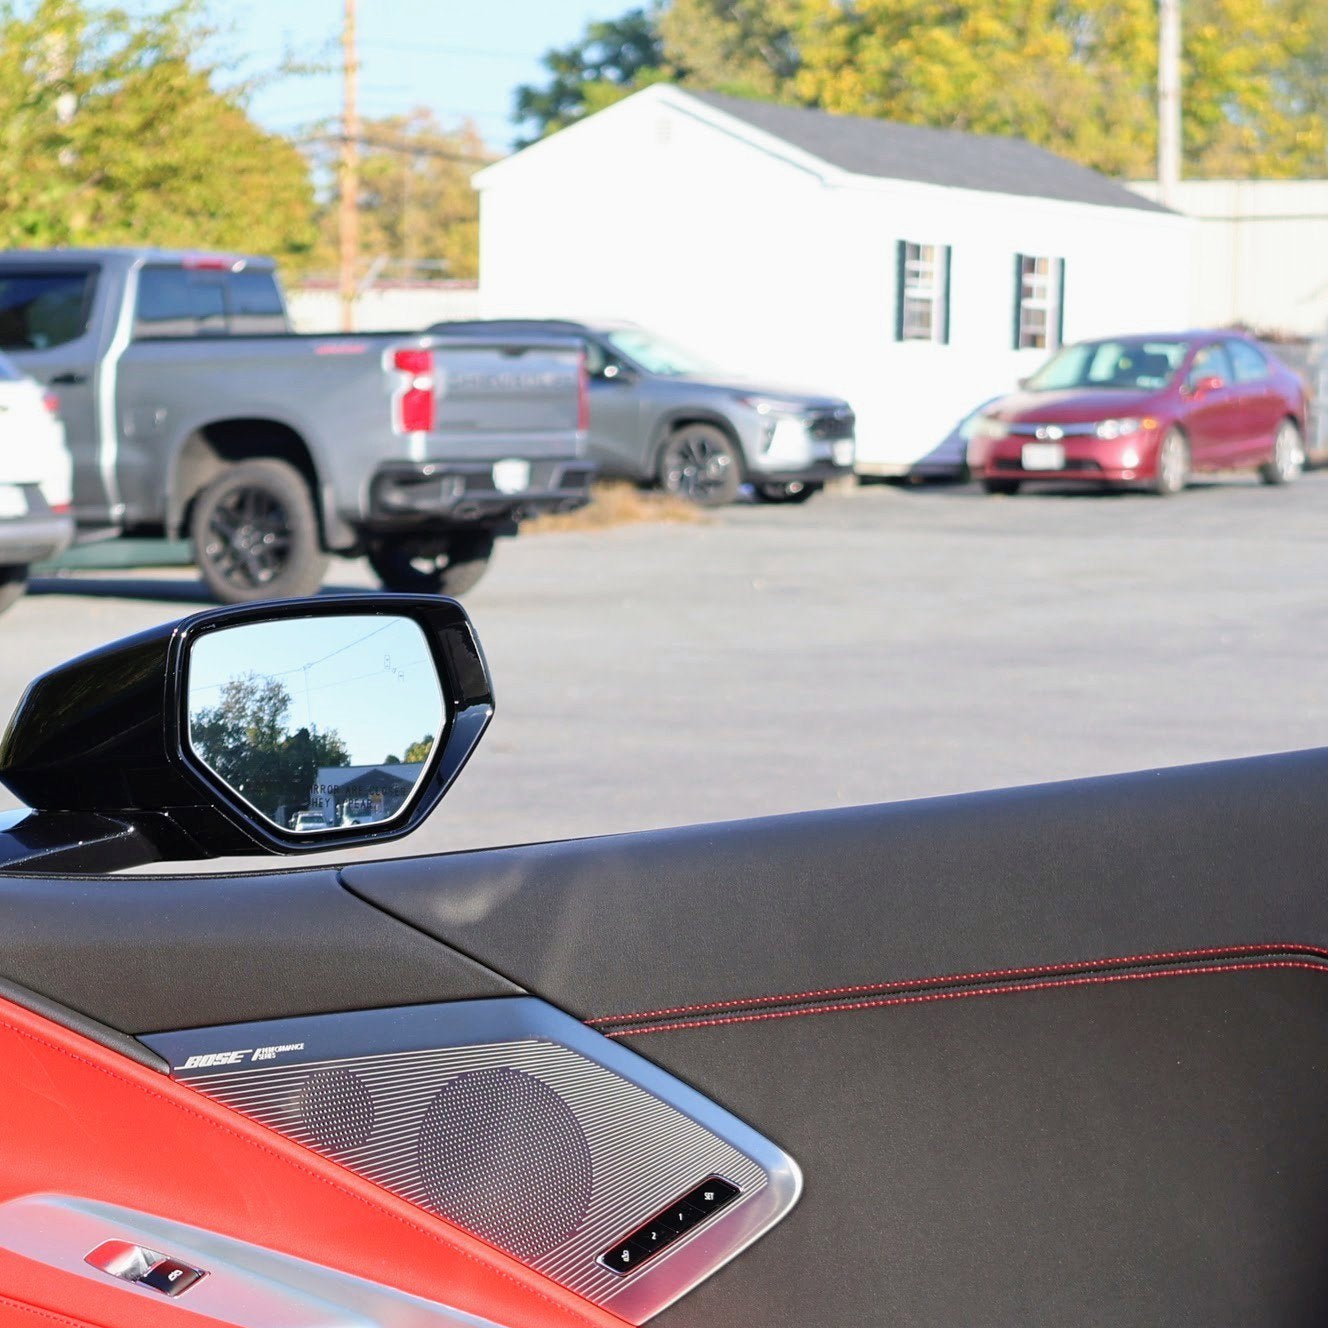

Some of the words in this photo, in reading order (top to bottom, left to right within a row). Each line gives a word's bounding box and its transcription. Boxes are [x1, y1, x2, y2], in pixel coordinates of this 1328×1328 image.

[304, 784, 339, 795] IRROR
[174, 1049, 252, 1070] BOSE
[703, 1191, 715, 1201] SET
